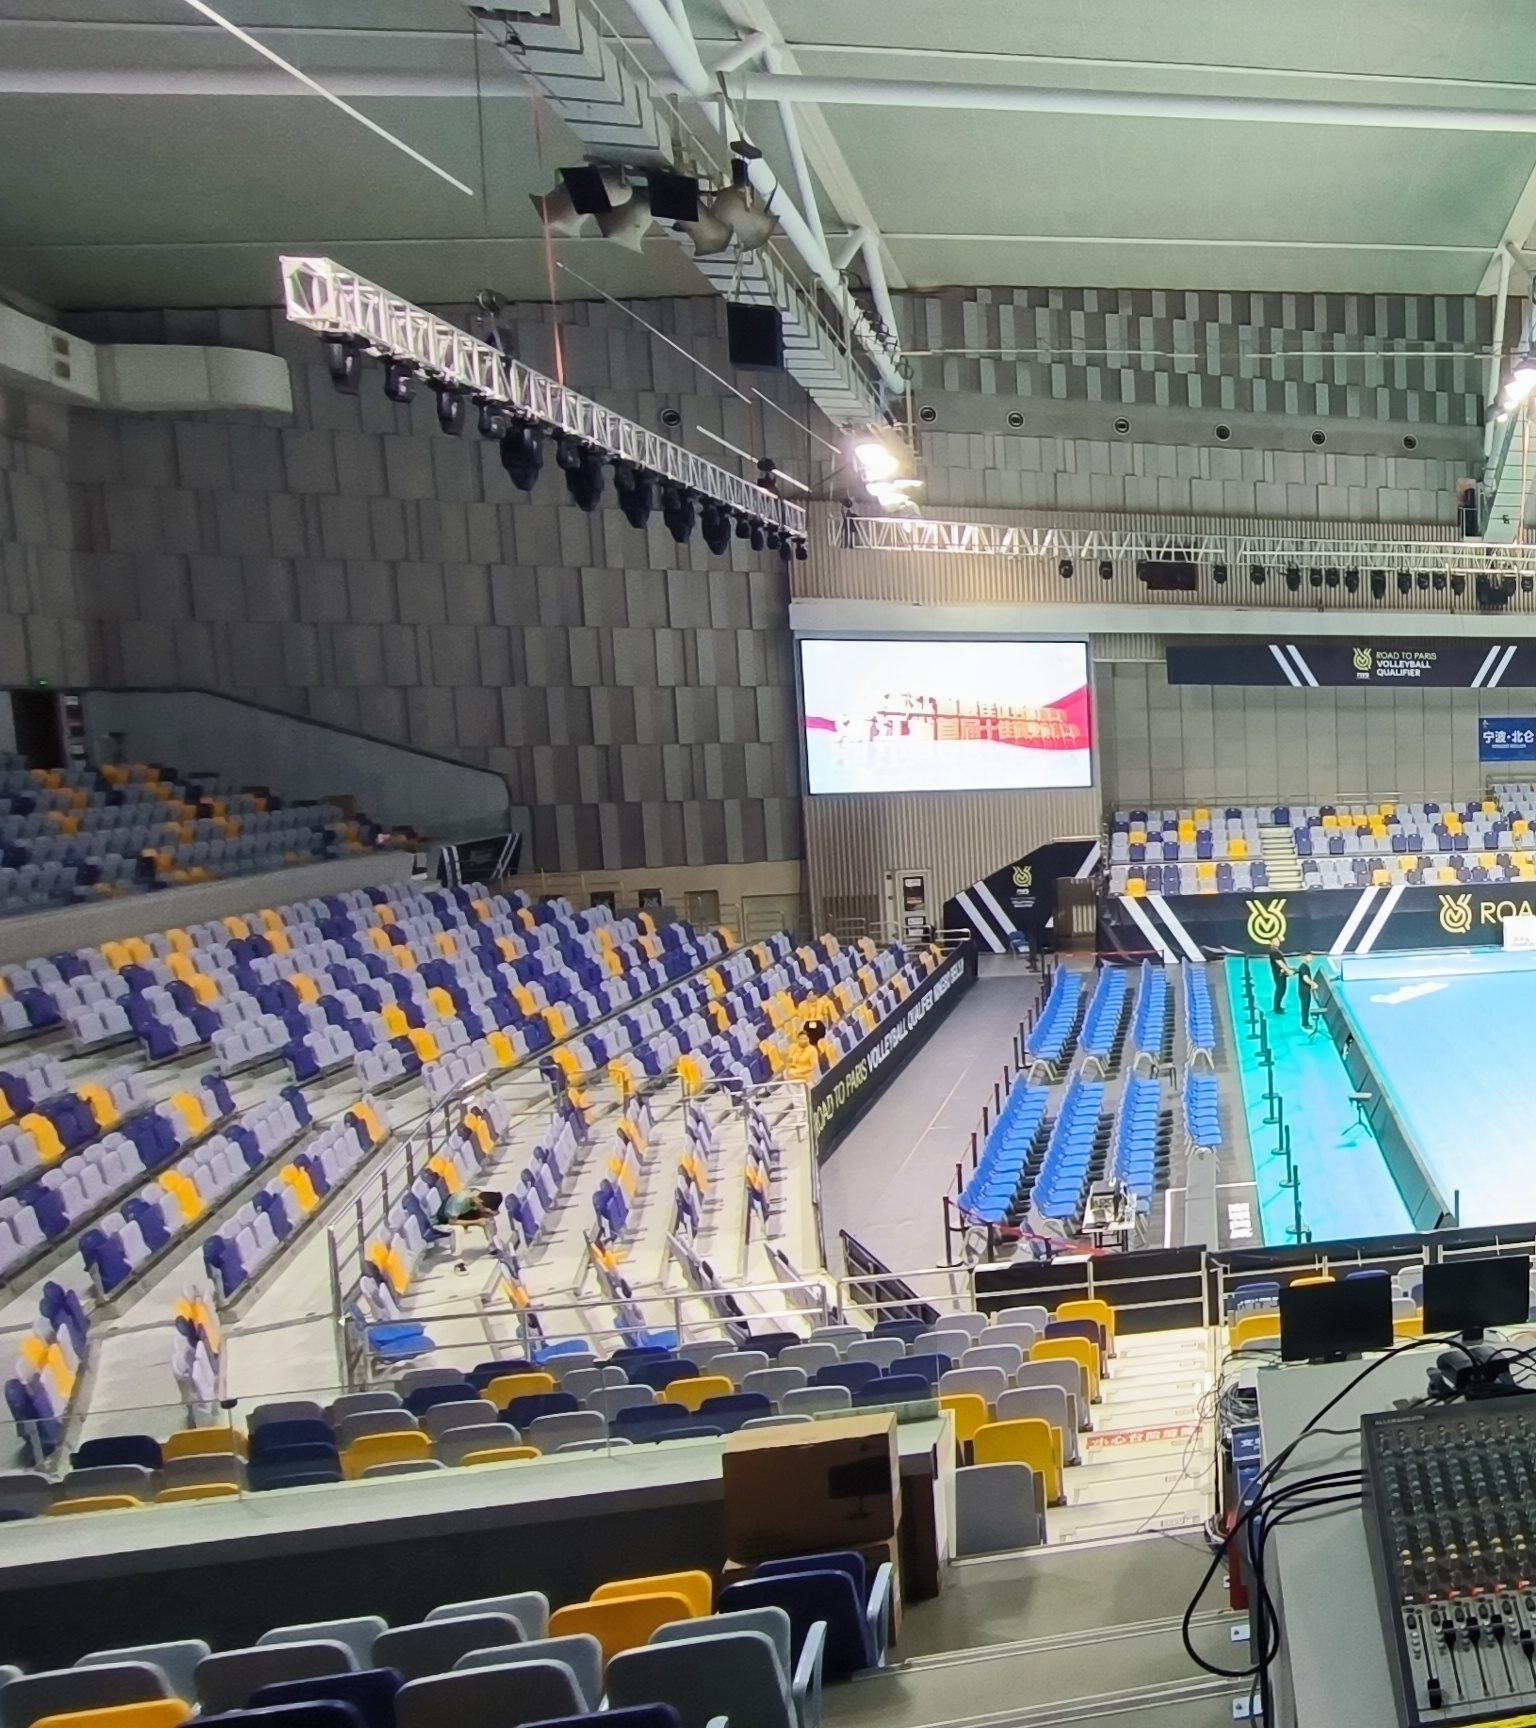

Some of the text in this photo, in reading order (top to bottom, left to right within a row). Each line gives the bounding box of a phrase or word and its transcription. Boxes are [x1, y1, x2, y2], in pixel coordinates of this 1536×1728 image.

[1376, 652, 1437, 660] ROAD TO PARIS
[1376, 660, 1432, 669] VOLLEYBALL
[1376, 668, 1421, 677] QUALIFIER
[1482, 730, 1535, 744] 宁波·北仑
[833, 1080, 846, 1109] TO
